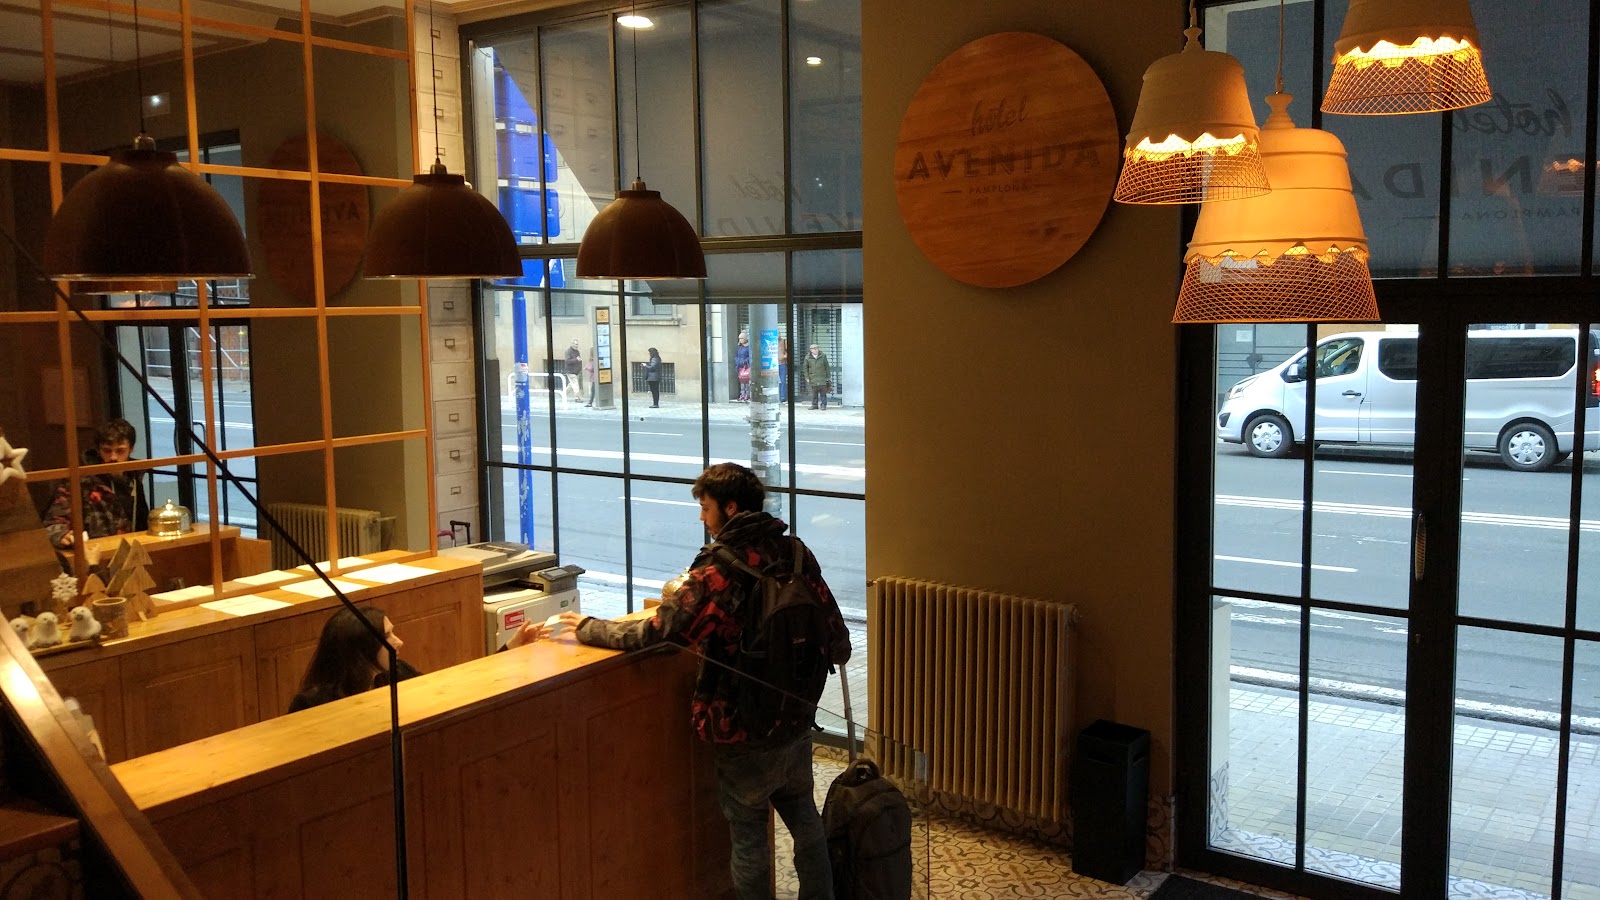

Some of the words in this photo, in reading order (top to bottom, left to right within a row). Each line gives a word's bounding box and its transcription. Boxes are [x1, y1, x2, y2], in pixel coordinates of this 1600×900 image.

[971, 96, 1028, 137] hotel
[906, 146, 1100, 183] AVENIDA
[969, 184, 1031, 195] PAMPLONA
